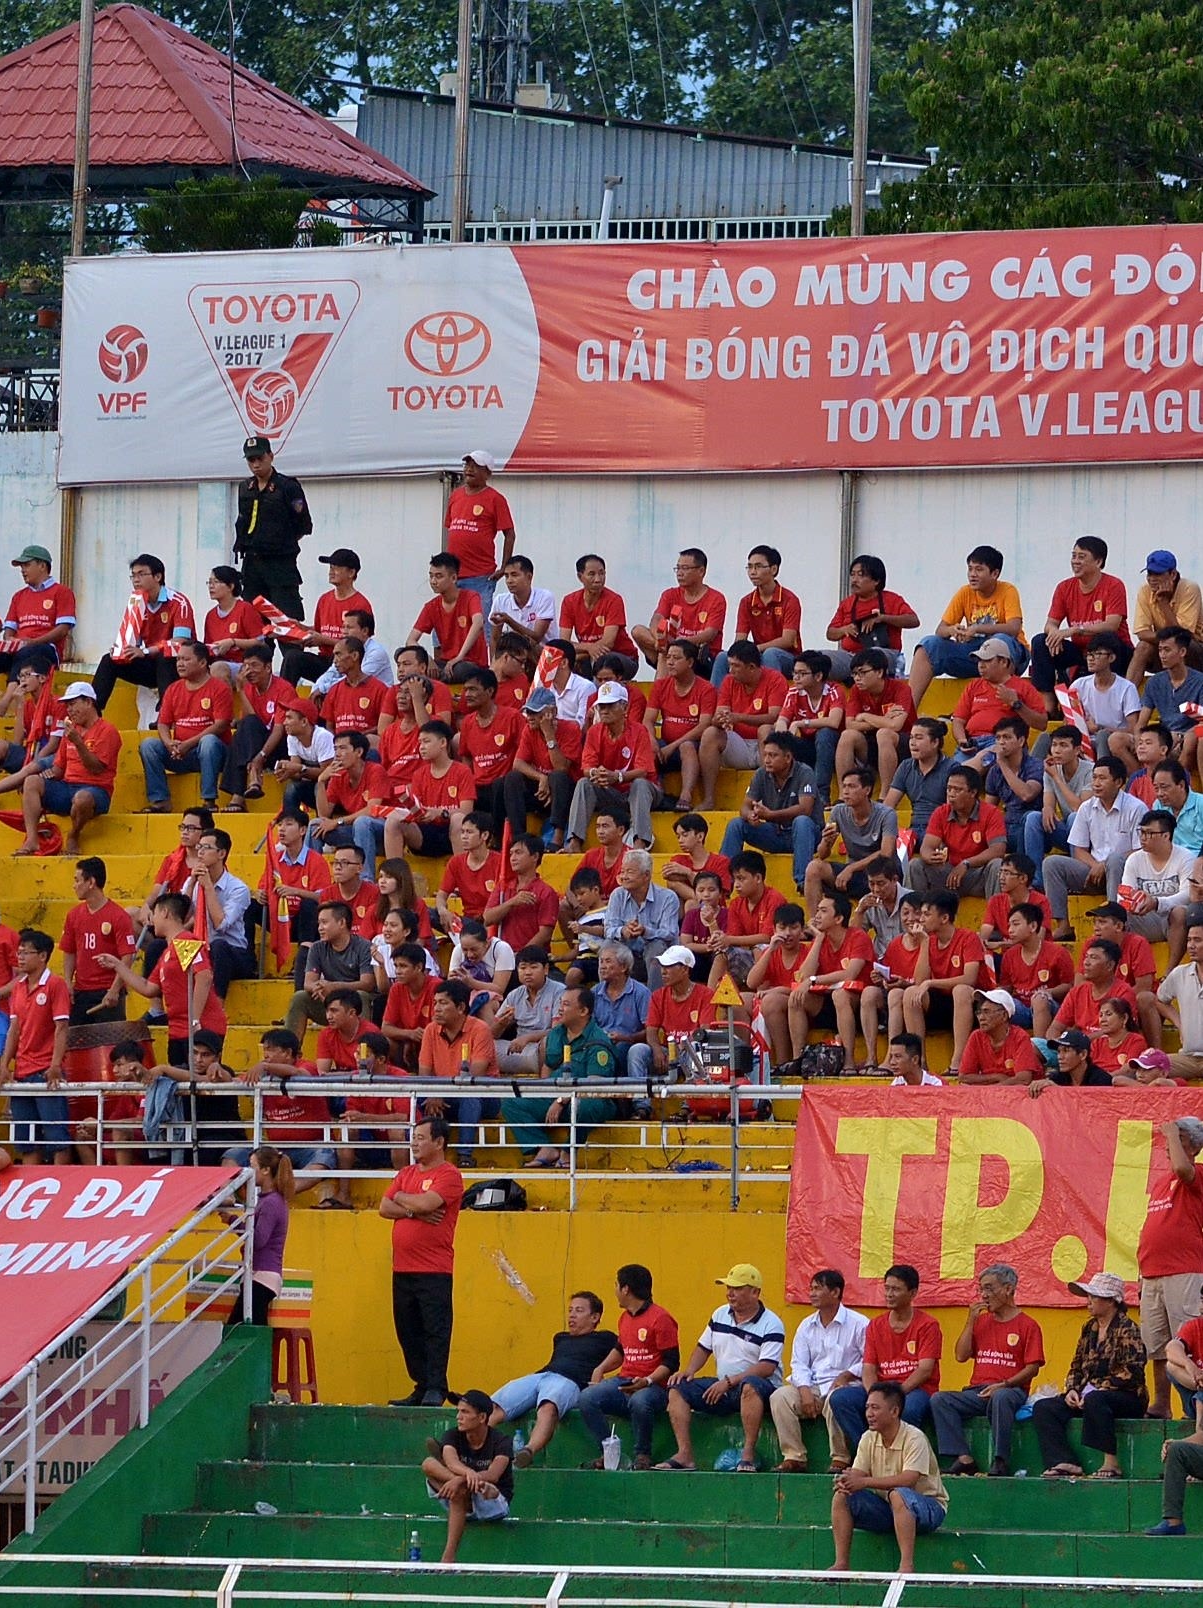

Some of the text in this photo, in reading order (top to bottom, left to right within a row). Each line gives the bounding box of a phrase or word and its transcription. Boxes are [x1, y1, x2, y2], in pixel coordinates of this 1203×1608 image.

[626, 243, 1203, 310] CHÀO MỪNG CÁC ĐỘ
[202, 293, 340, 324] TOYOTA
[214, 333, 286, 351] V.LEAGUE 1
[576, 326, 666, 383] GIẢI
[685, 326, 811, 381] BÓNG
[827, 322, 890, 377] ĐÁ
[907, 319, 971, 375] VÔ
[988, 326, 1105, 382] ĐỊCH
[225, 352, 264, 366] 2017
[97, 391, 147, 414] VPF
[387, 384, 504, 410] TOYOTA
[821, 395, 1002, 443] TOYOTA
[84, 932, 96, 950] 18
[64, 1169, 174, 1220] ĐÁ
